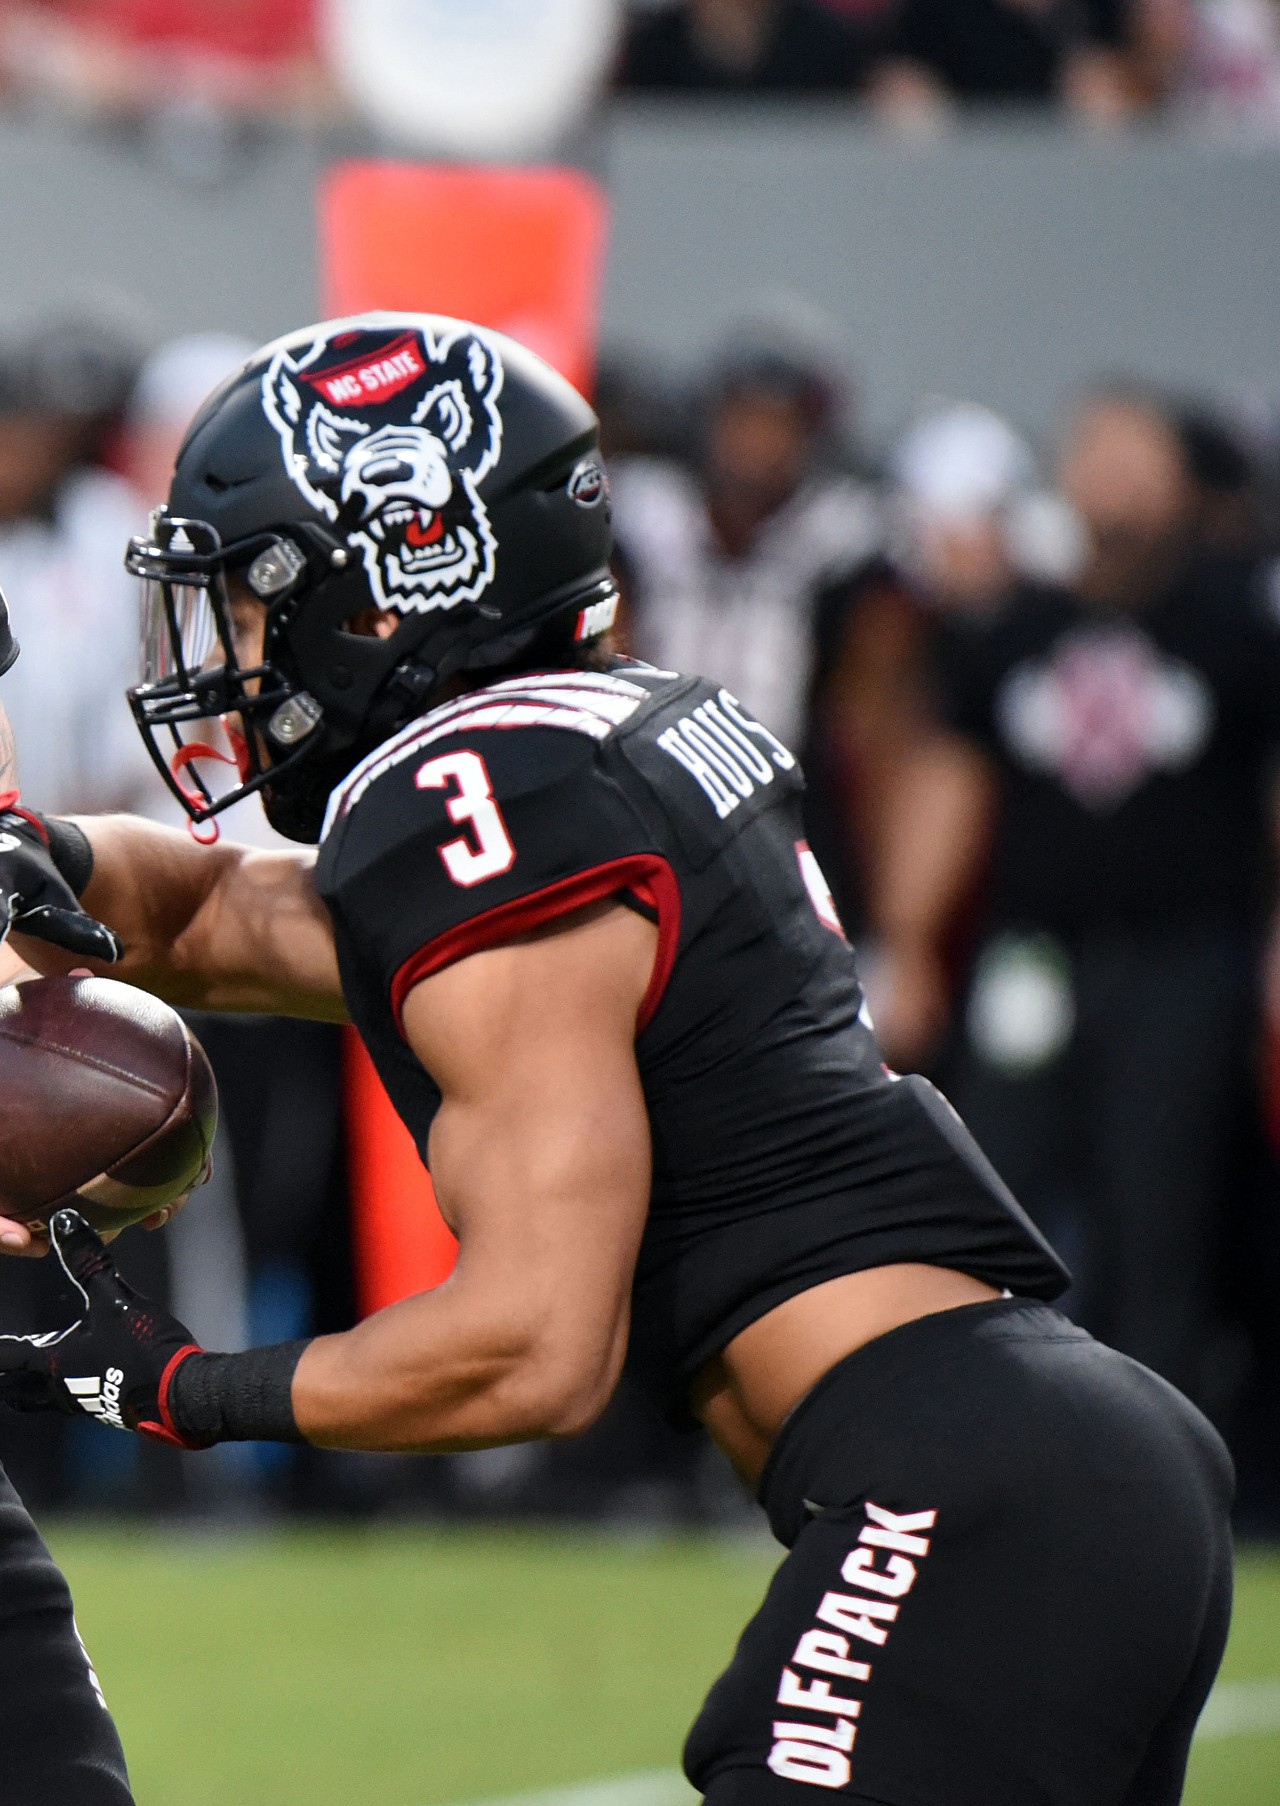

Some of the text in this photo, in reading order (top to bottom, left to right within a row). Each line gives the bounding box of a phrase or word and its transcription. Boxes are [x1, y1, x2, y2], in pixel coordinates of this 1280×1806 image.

[326, 350, 419, 403] NC STATE
[416, 749, 516, 888] 3
